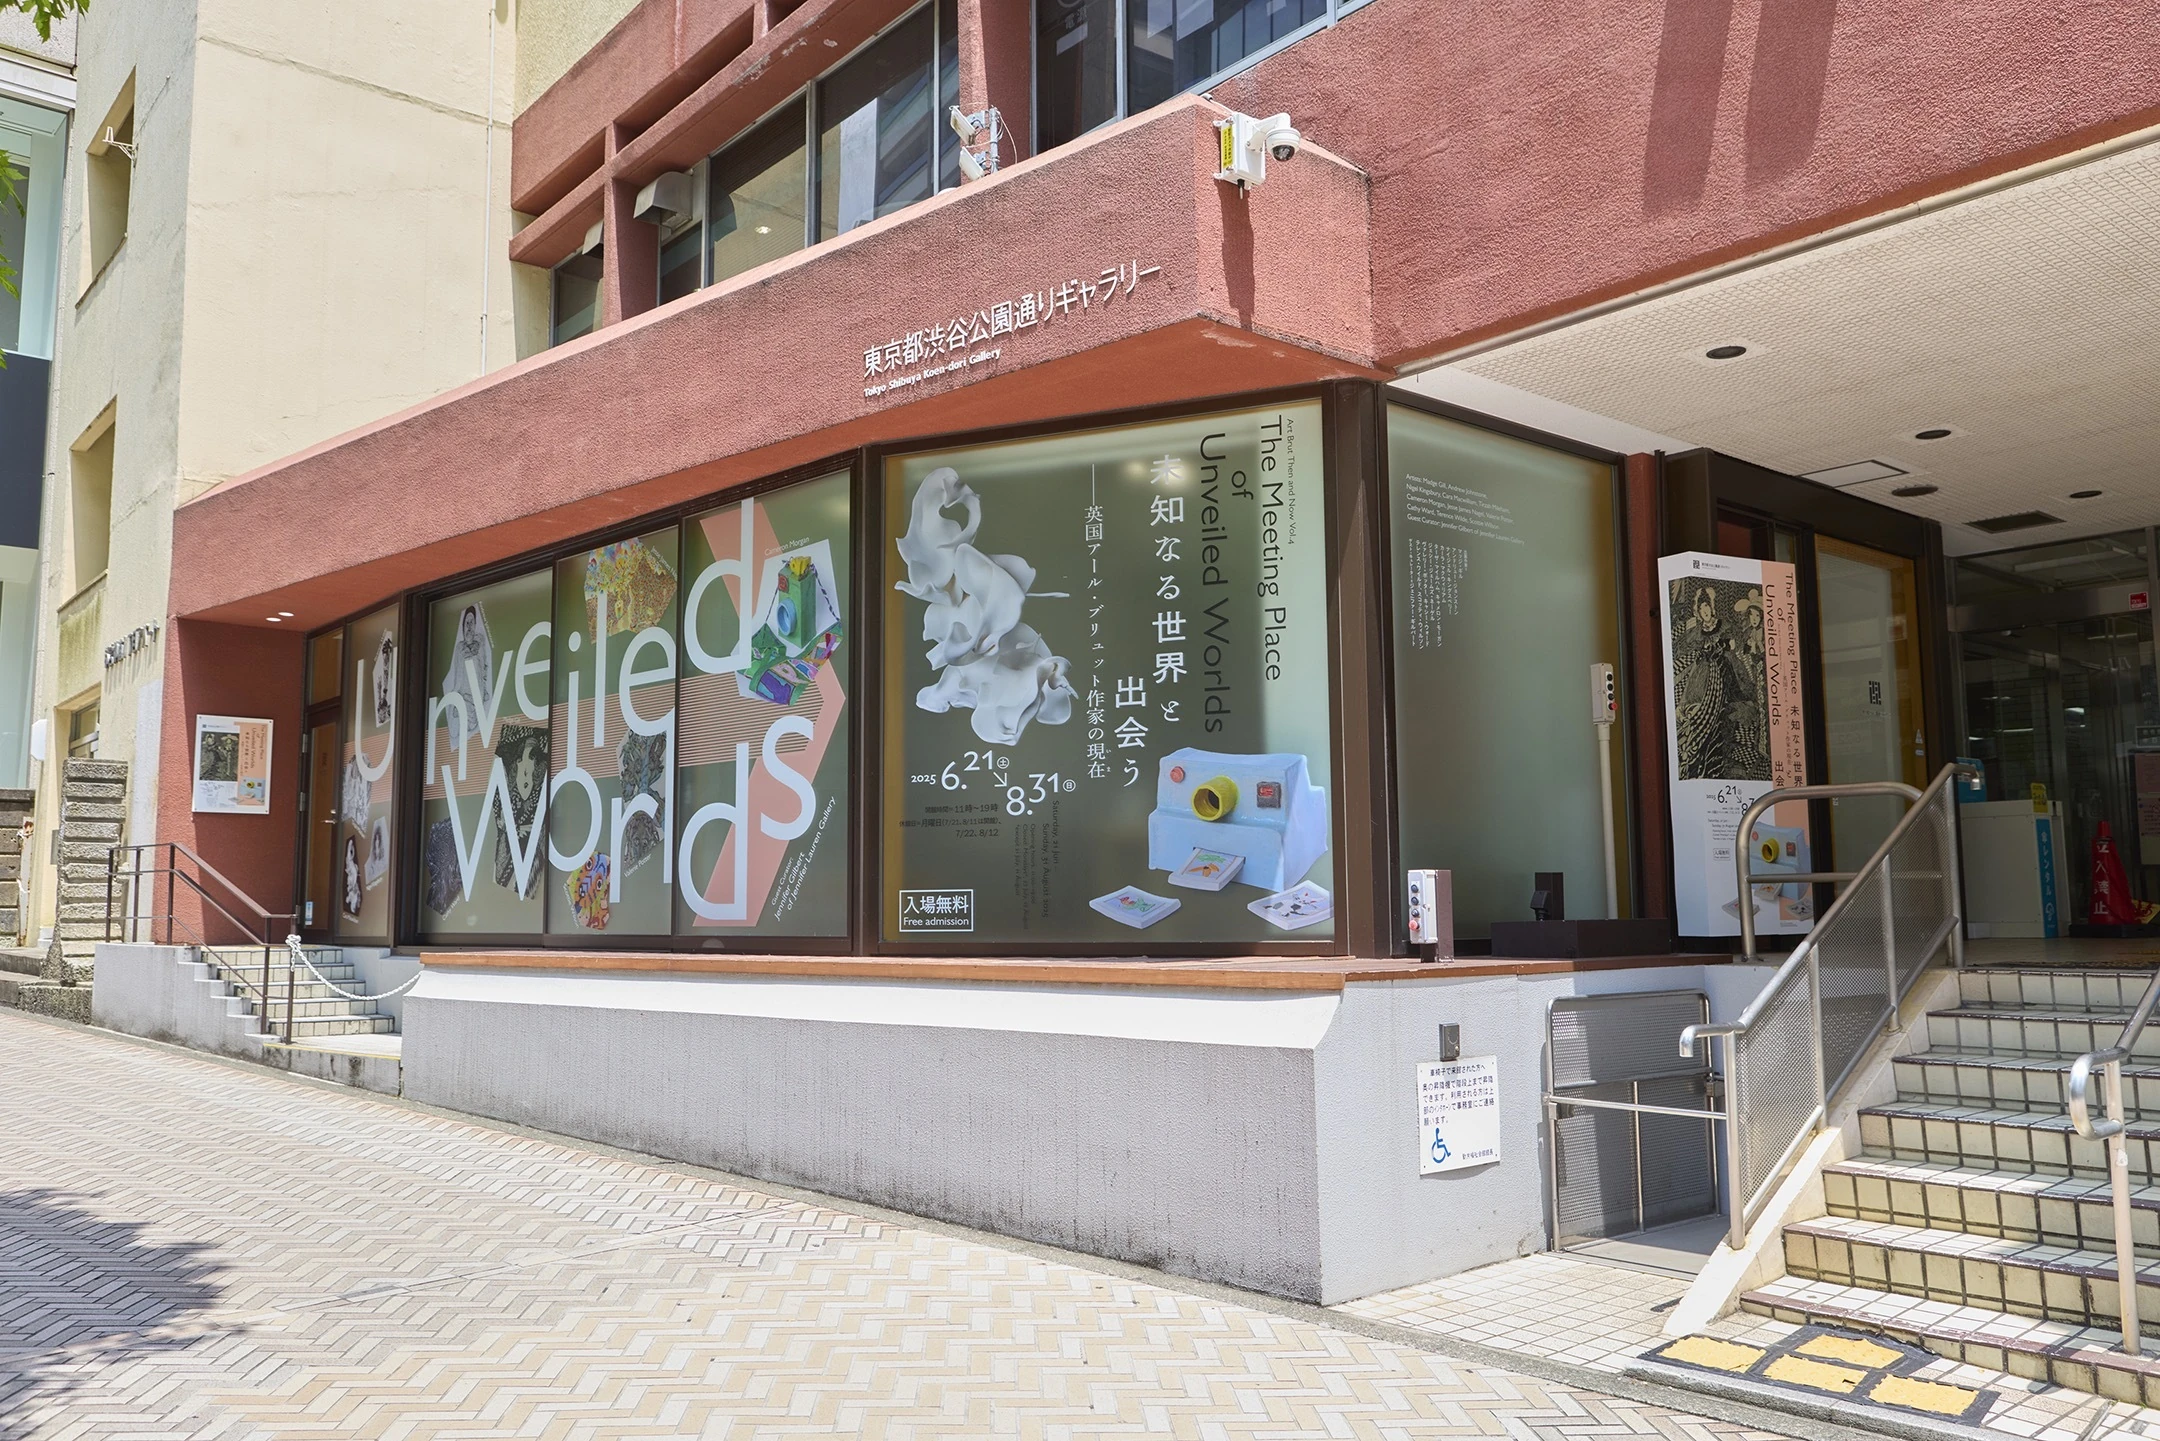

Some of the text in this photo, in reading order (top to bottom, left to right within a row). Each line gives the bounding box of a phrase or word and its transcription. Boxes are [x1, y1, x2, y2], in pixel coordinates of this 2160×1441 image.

[863, 259, 1161, 378] 東京都渋谷公園通りギャラリー
[863, 349, 1001, 397] Tokyo Shibuya Koen-dori Gallery
[1231, 470, 1254, 500] of
[1288, 499, 1296, 520] Now
[764, 536, 810, 556] Cameron Morgan
[1257, 414, 1286, 681] The Meeting Place
[1150, 454, 1187, 722] 未知なる世界と
[1200, 432, 1231, 733] Unveiled Worlds
[354, 497, 754, 785] Unveiled
[1766, 584, 1778, 657] Unveiled
[1777, 608, 1786, 623] of
[1786, 572, 1799, 695] The Meeting Place
[1770, 662, 1782, 726] Worlds
[1114, 676, 1149, 787] 出会う
[911, 774, 936, 785] 2025
[941, 750, 993, 790] 6.21
[1006, 772, 1059, 816] 8.31
[441, 707, 817, 921] Worlds
[1042, 823, 1050, 854] Sunday,
[771, 857, 794, 905] Guest Curator:
[787, 796, 836, 910] of Jennifer Lauren Gallery
[774, 852, 805, 921] Jennifer Gilbert
[903, 894, 969, 915] 入場無料
[1042, 867, 1050, 896] August
[903, 916, 969, 926] Free admission
